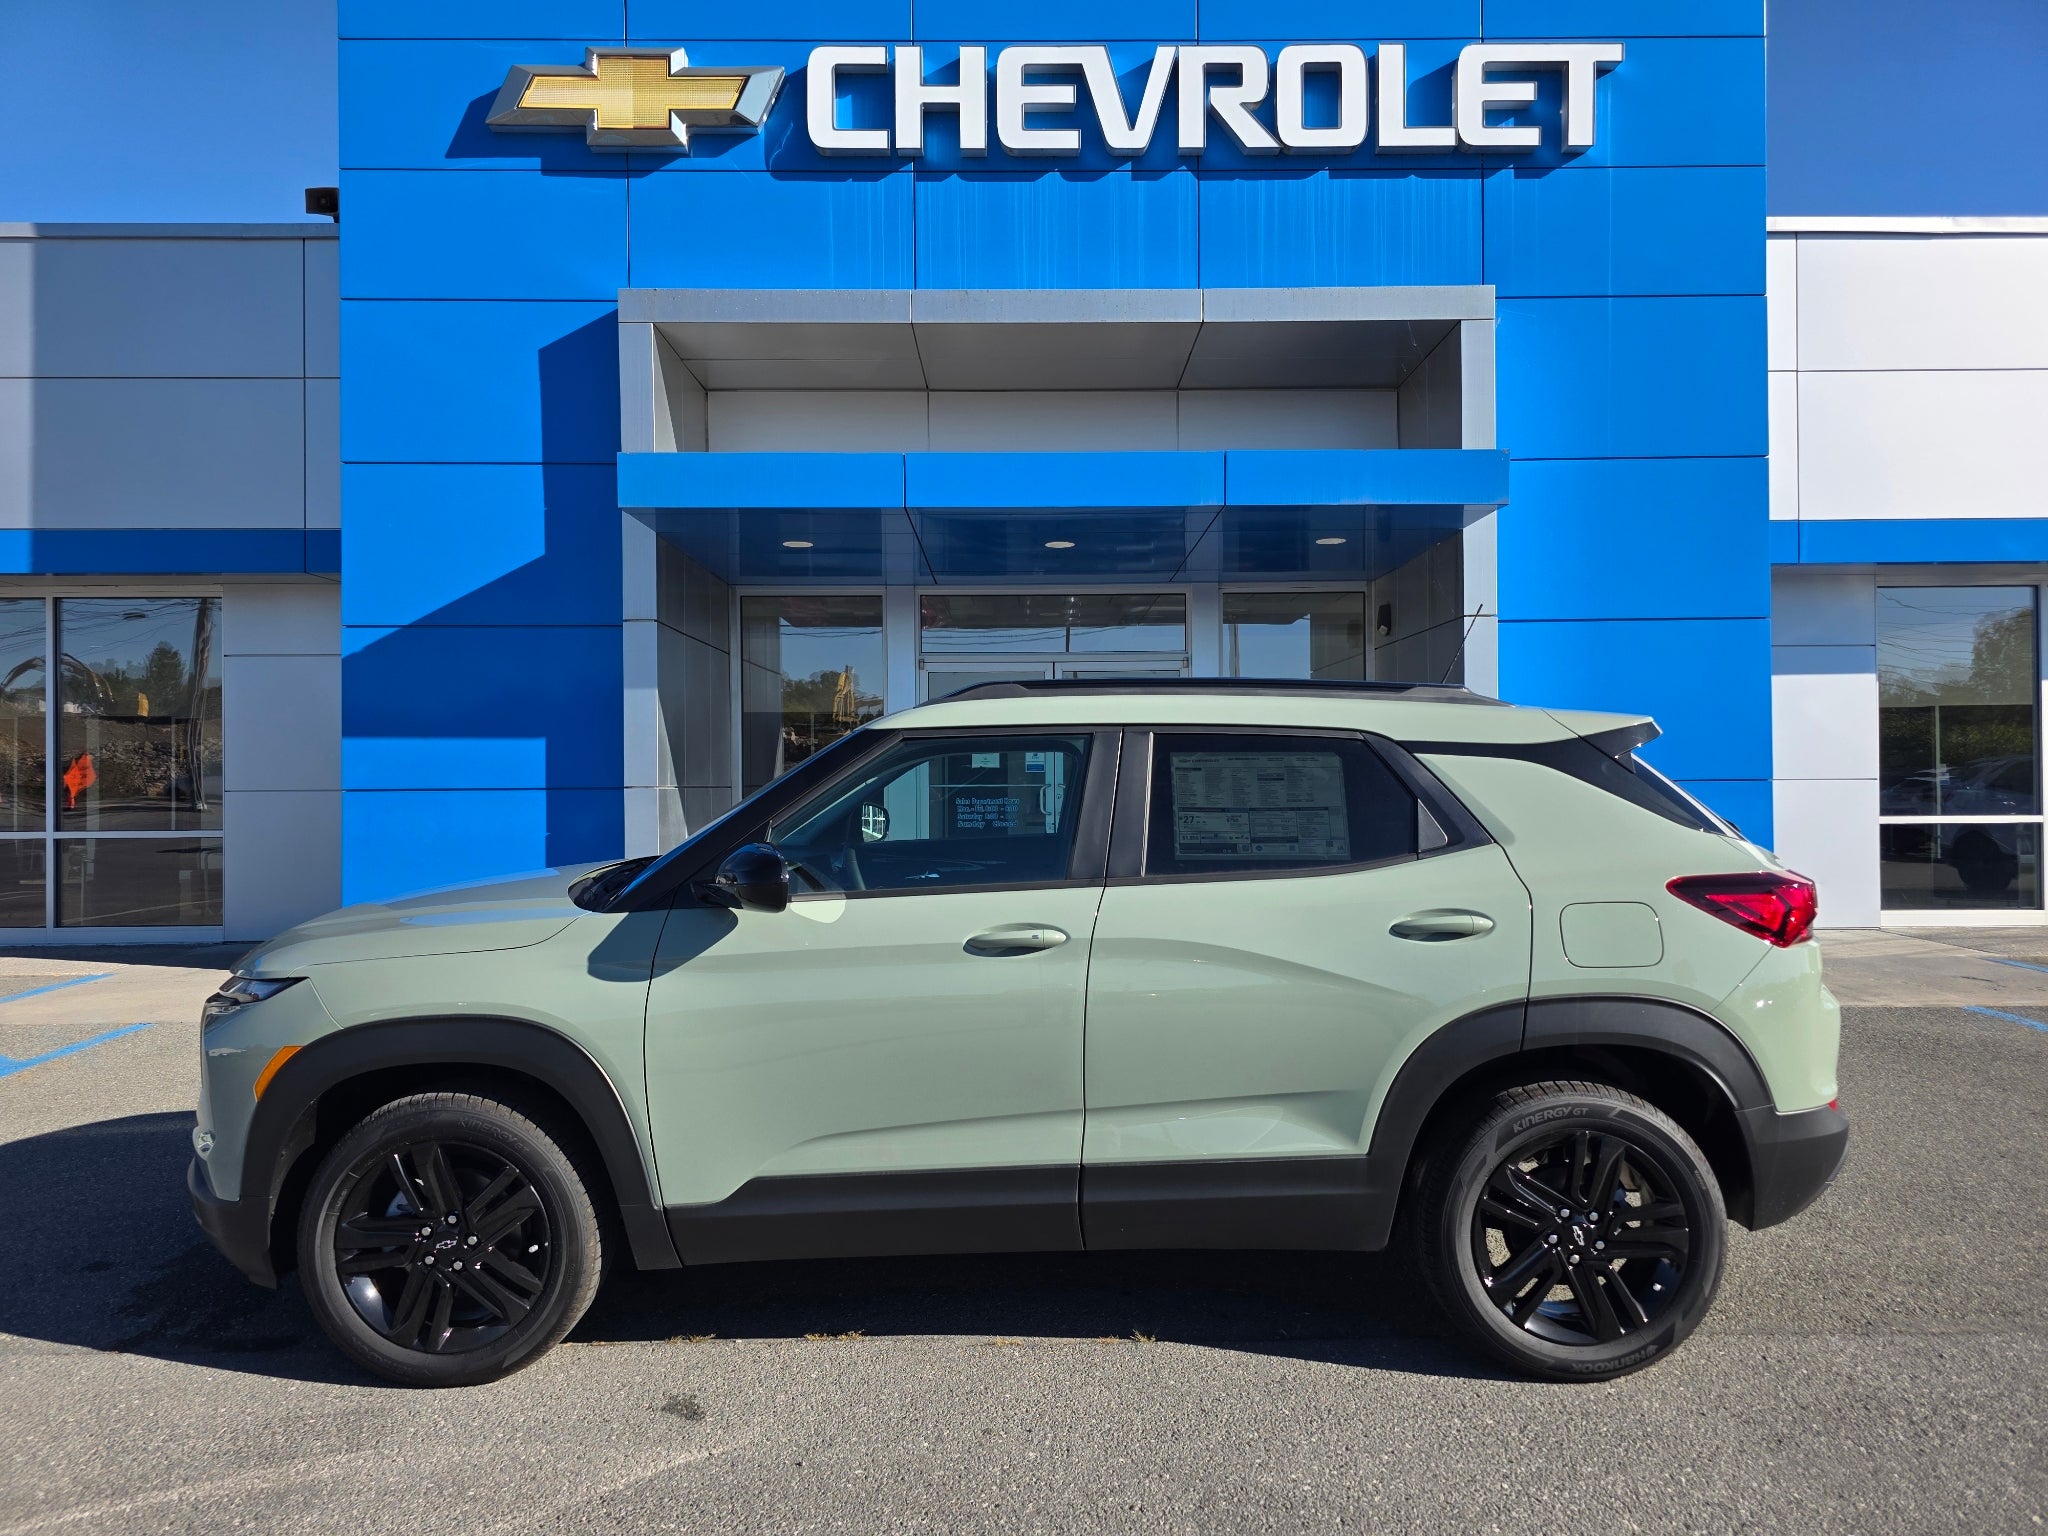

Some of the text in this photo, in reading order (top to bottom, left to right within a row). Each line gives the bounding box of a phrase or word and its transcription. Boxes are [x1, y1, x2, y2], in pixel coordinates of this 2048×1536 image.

[806, 42, 1624, 155] CHEVROLET
[957, 820, 986, 829] Sunday
[1183, 815, 1194, 824] 27
[456, 1117, 518, 1143] KINERGY
[1512, 1106, 1589, 1133] KINERGY GT
